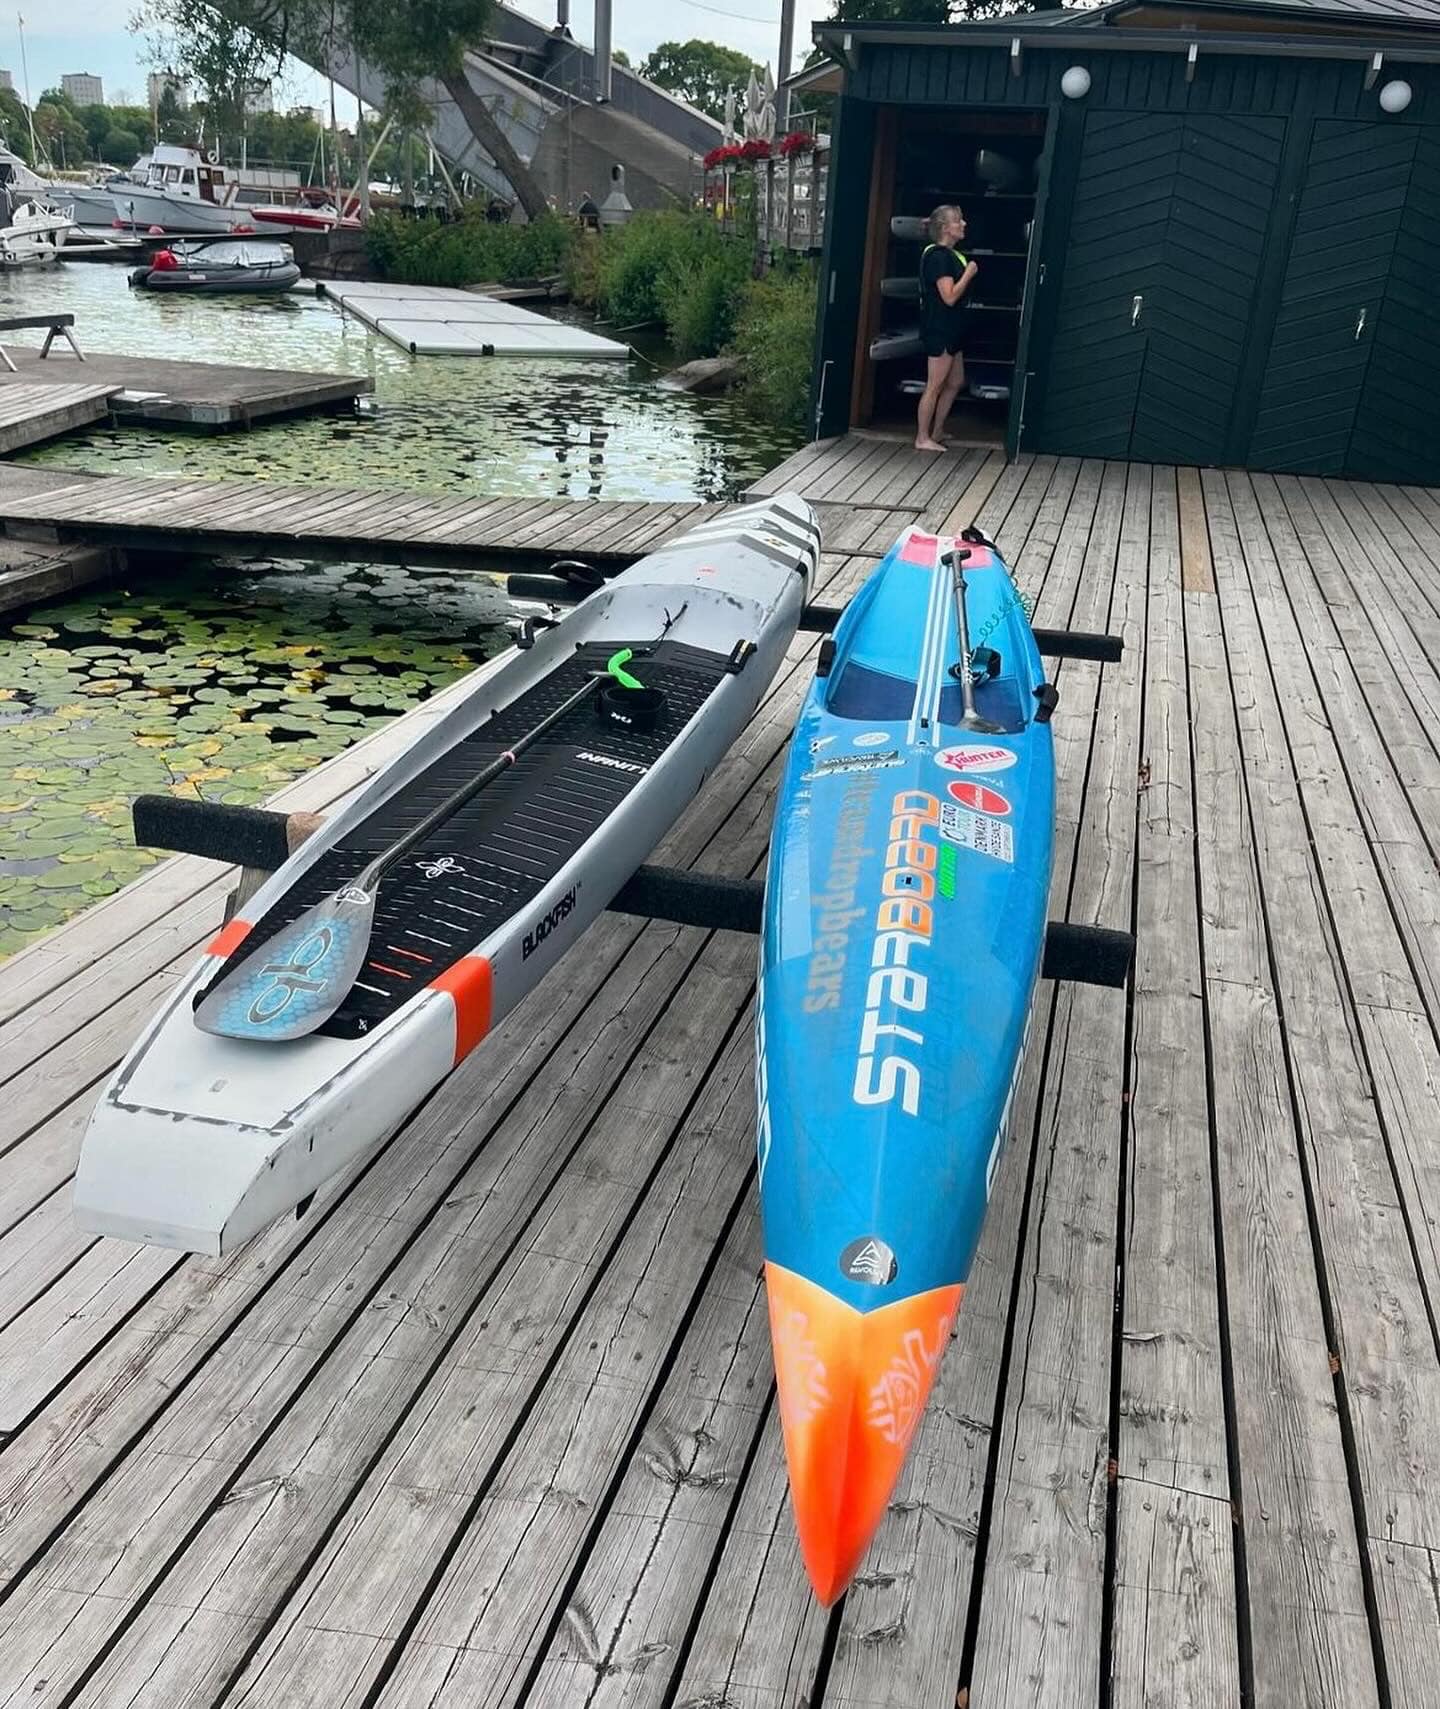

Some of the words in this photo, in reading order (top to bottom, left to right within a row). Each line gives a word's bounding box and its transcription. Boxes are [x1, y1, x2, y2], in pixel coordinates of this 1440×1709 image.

[576, 752, 649, 775] INFINITY
[955, 750, 1007, 764] HUNTER
[942, 804, 956, 827] EURO
[974, 816, 987, 853] DENMARK
[522, 886, 577, 962] BLACKFISH
